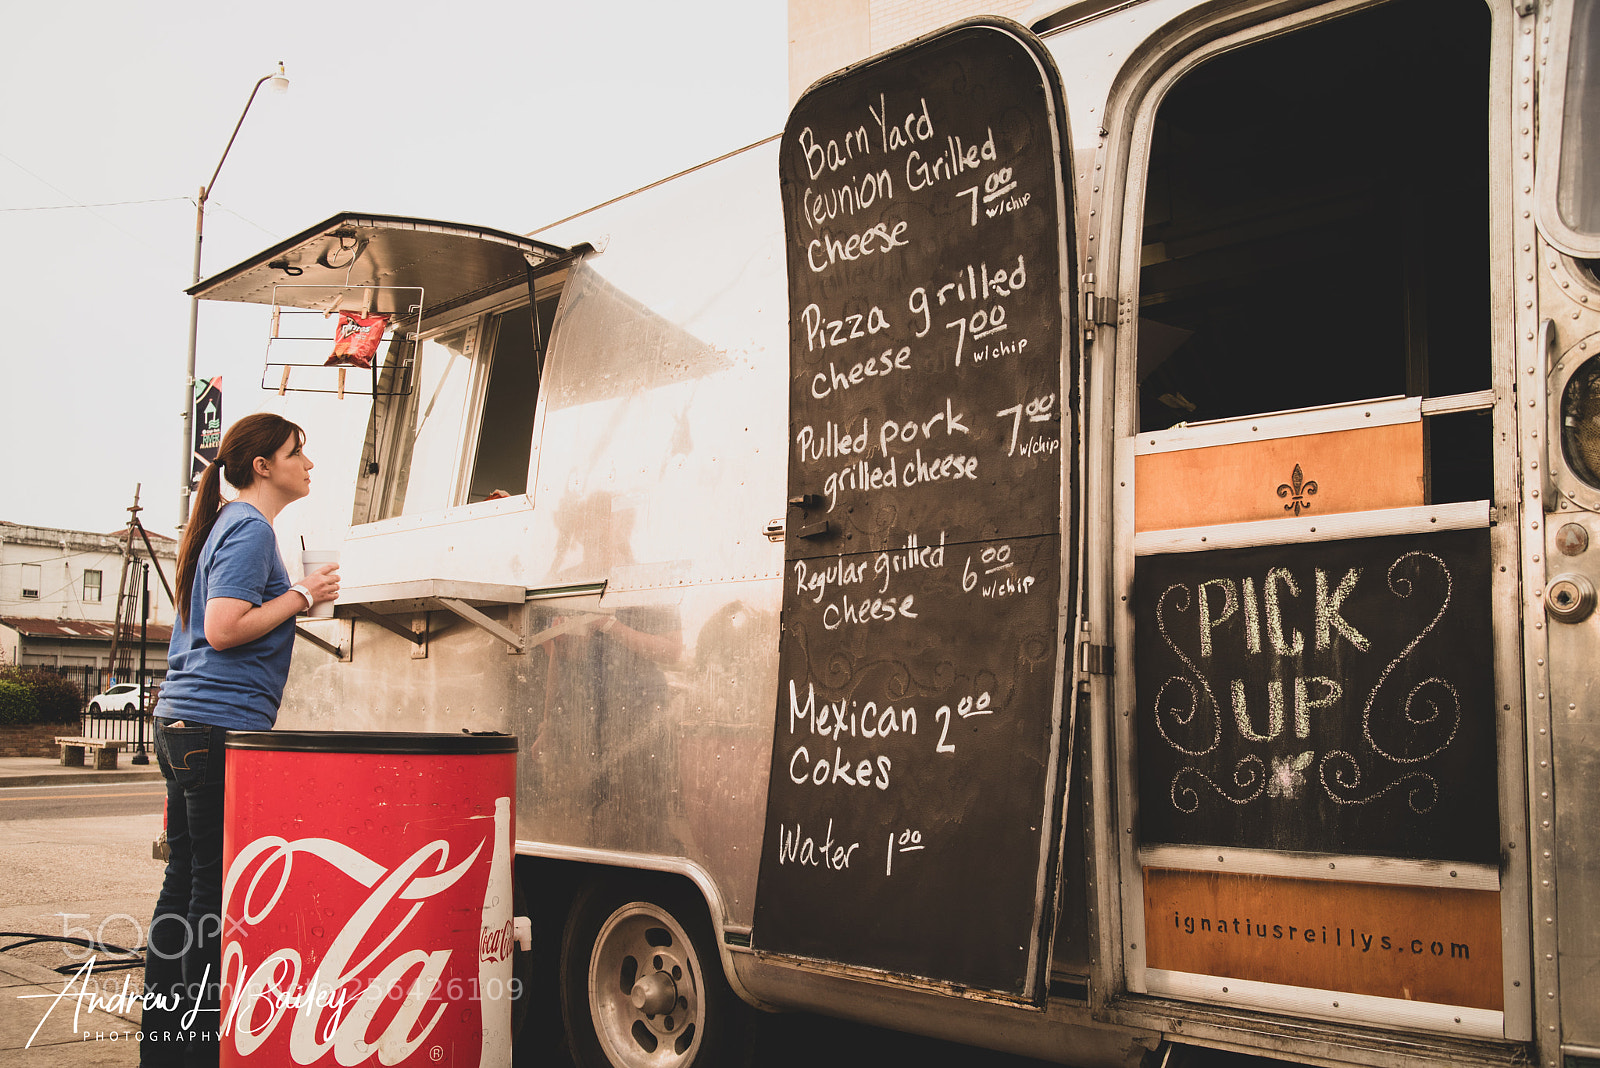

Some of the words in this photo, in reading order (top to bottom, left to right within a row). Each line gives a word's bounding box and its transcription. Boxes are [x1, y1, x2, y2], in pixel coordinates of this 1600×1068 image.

[799, 126, 870, 181] Barn
[868, 92, 934, 153] Yard
[906, 125, 997, 192] Grilled
[801, 303, 890, 352] Pizza
[909, 254, 1027, 338] grilled
[796, 417, 869, 462] Pulled
[880, 397, 970, 457] pork
[823, 456, 897, 513] grilled
[902, 449, 979, 488] cheese
[794, 553, 868, 604] Regular
[873, 531, 946, 594] grilled
[1198, 565, 1373, 658] PICK
[788, 679, 918, 741] Mexican
[1230, 675, 1343, 743] UP
[789, 746, 892, 790] Cokes
[778, 818, 860, 871] Water
[1174, 911, 1470, 961] ignatiusreillys.com
